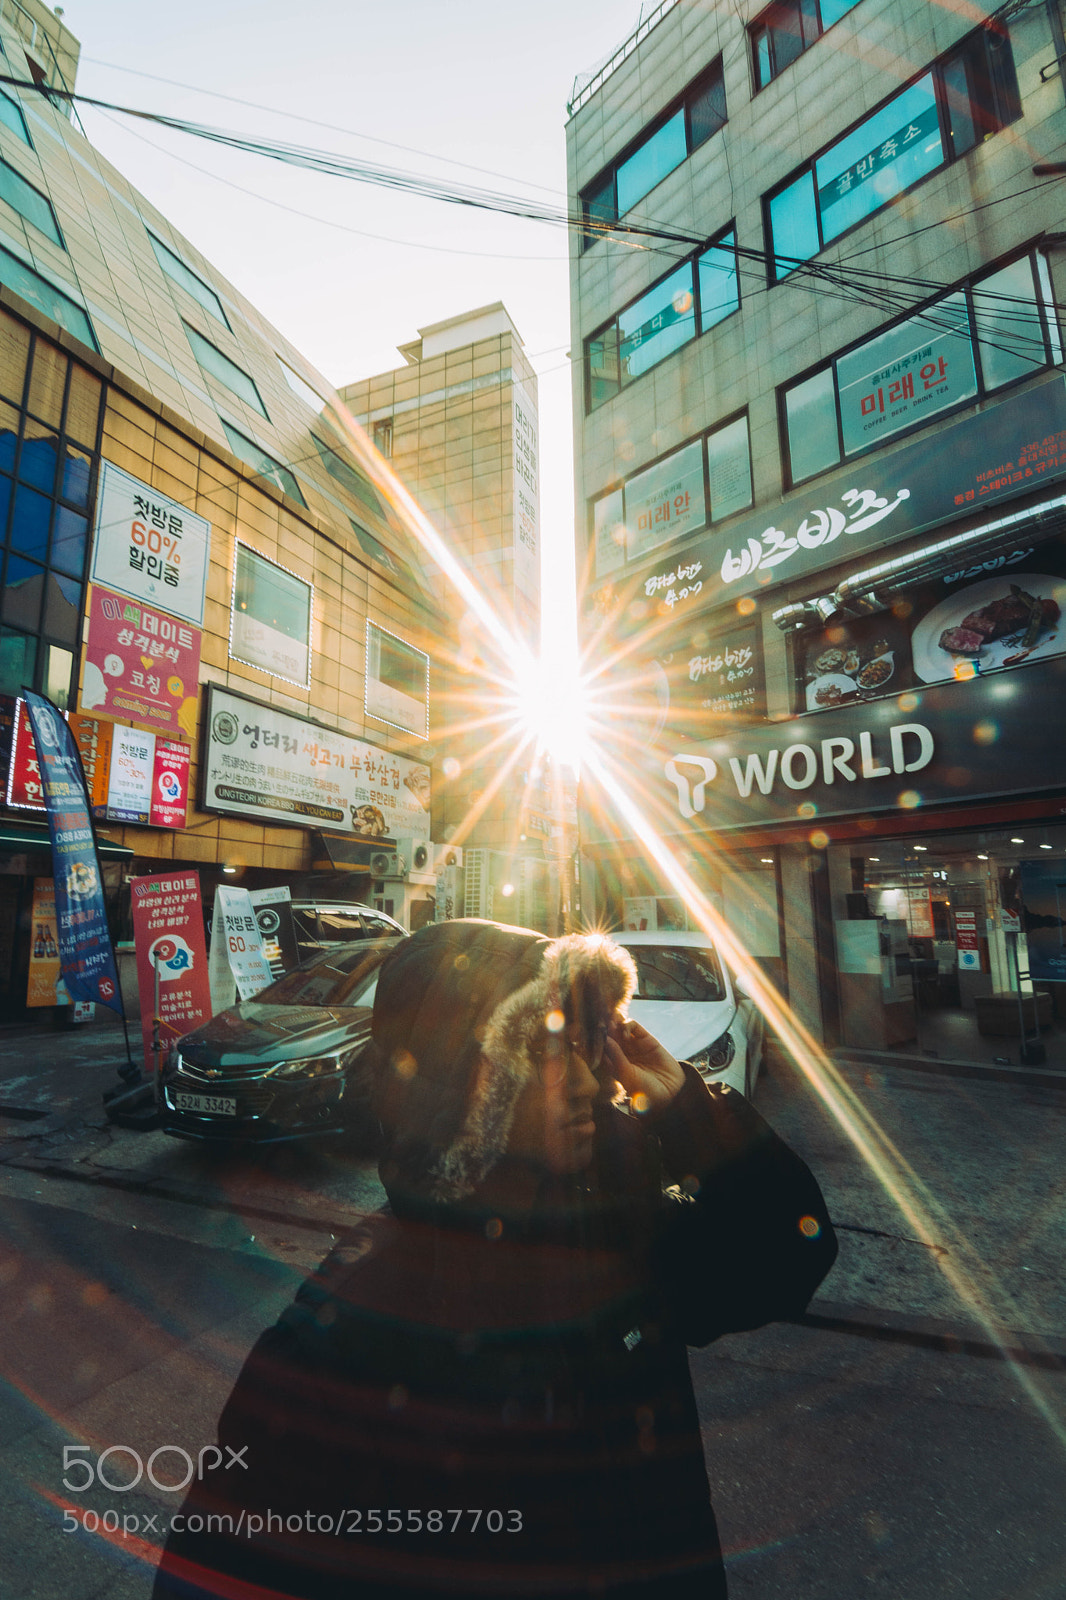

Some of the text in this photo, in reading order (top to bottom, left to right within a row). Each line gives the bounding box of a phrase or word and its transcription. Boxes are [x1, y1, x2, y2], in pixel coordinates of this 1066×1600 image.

[835, 124, 922, 195] 골반축소
[860, 355, 948, 416] 미래안
[863, 385, 949, 431] COFFEE BEER DRINK TEA
[134, 494, 183, 539] 첫방문
[637, 490, 691, 531] 미래안
[131, 520, 181, 565] 60%
[719, 487, 911, 584] 비츠비츠
[129, 545, 180, 587] 할인중
[101, 597, 194, 650] 이색데이트
[116, 628, 180, 664] 성격분석
[129, 670, 161, 696] 코칭
[112, 695, 172, 721] coming soon
[120, 742, 149, 760] 첫방문
[242, 724, 298, 755] 엉터리
[302, 742, 345, 769] 생고기
[729, 722, 935, 798] WORLD
[218, 788, 257, 803] UNGTEORI
[256, 795, 281, 809] KOREA
[280, 800, 295, 811] BBQ
[306, 805, 319, 815] YOU
[319, 808, 331, 817] CAN
[332, 810, 343, 819] EAT
[135, 878, 197, 897] 이색데이트
[225, 914, 256, 932] 첫방문
[203, 1096, 232, 1113] 3342
